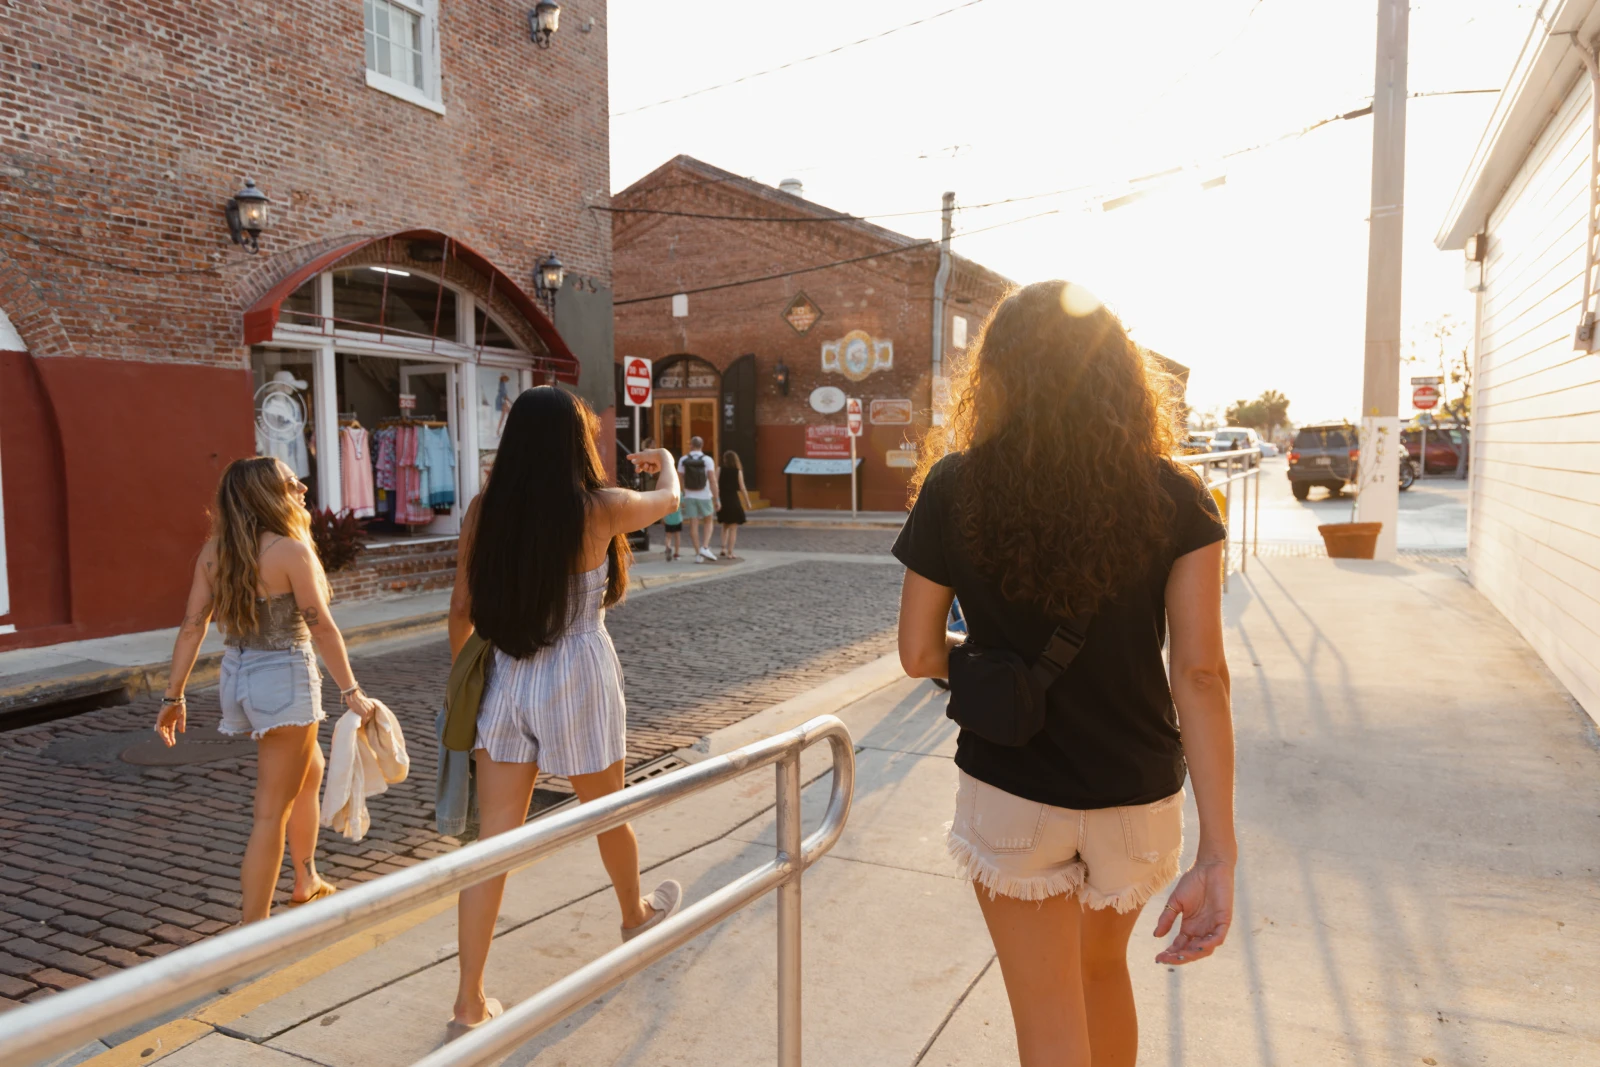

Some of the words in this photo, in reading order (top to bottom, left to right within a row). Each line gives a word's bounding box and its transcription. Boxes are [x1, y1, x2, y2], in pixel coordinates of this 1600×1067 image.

[628, 366, 637, 375] DO
[638, 367, 648, 376] NOT
[659, 377, 683, 389] GIFT
[688, 375, 716, 388] SHOP
[630, 386, 647, 397] ENTER
